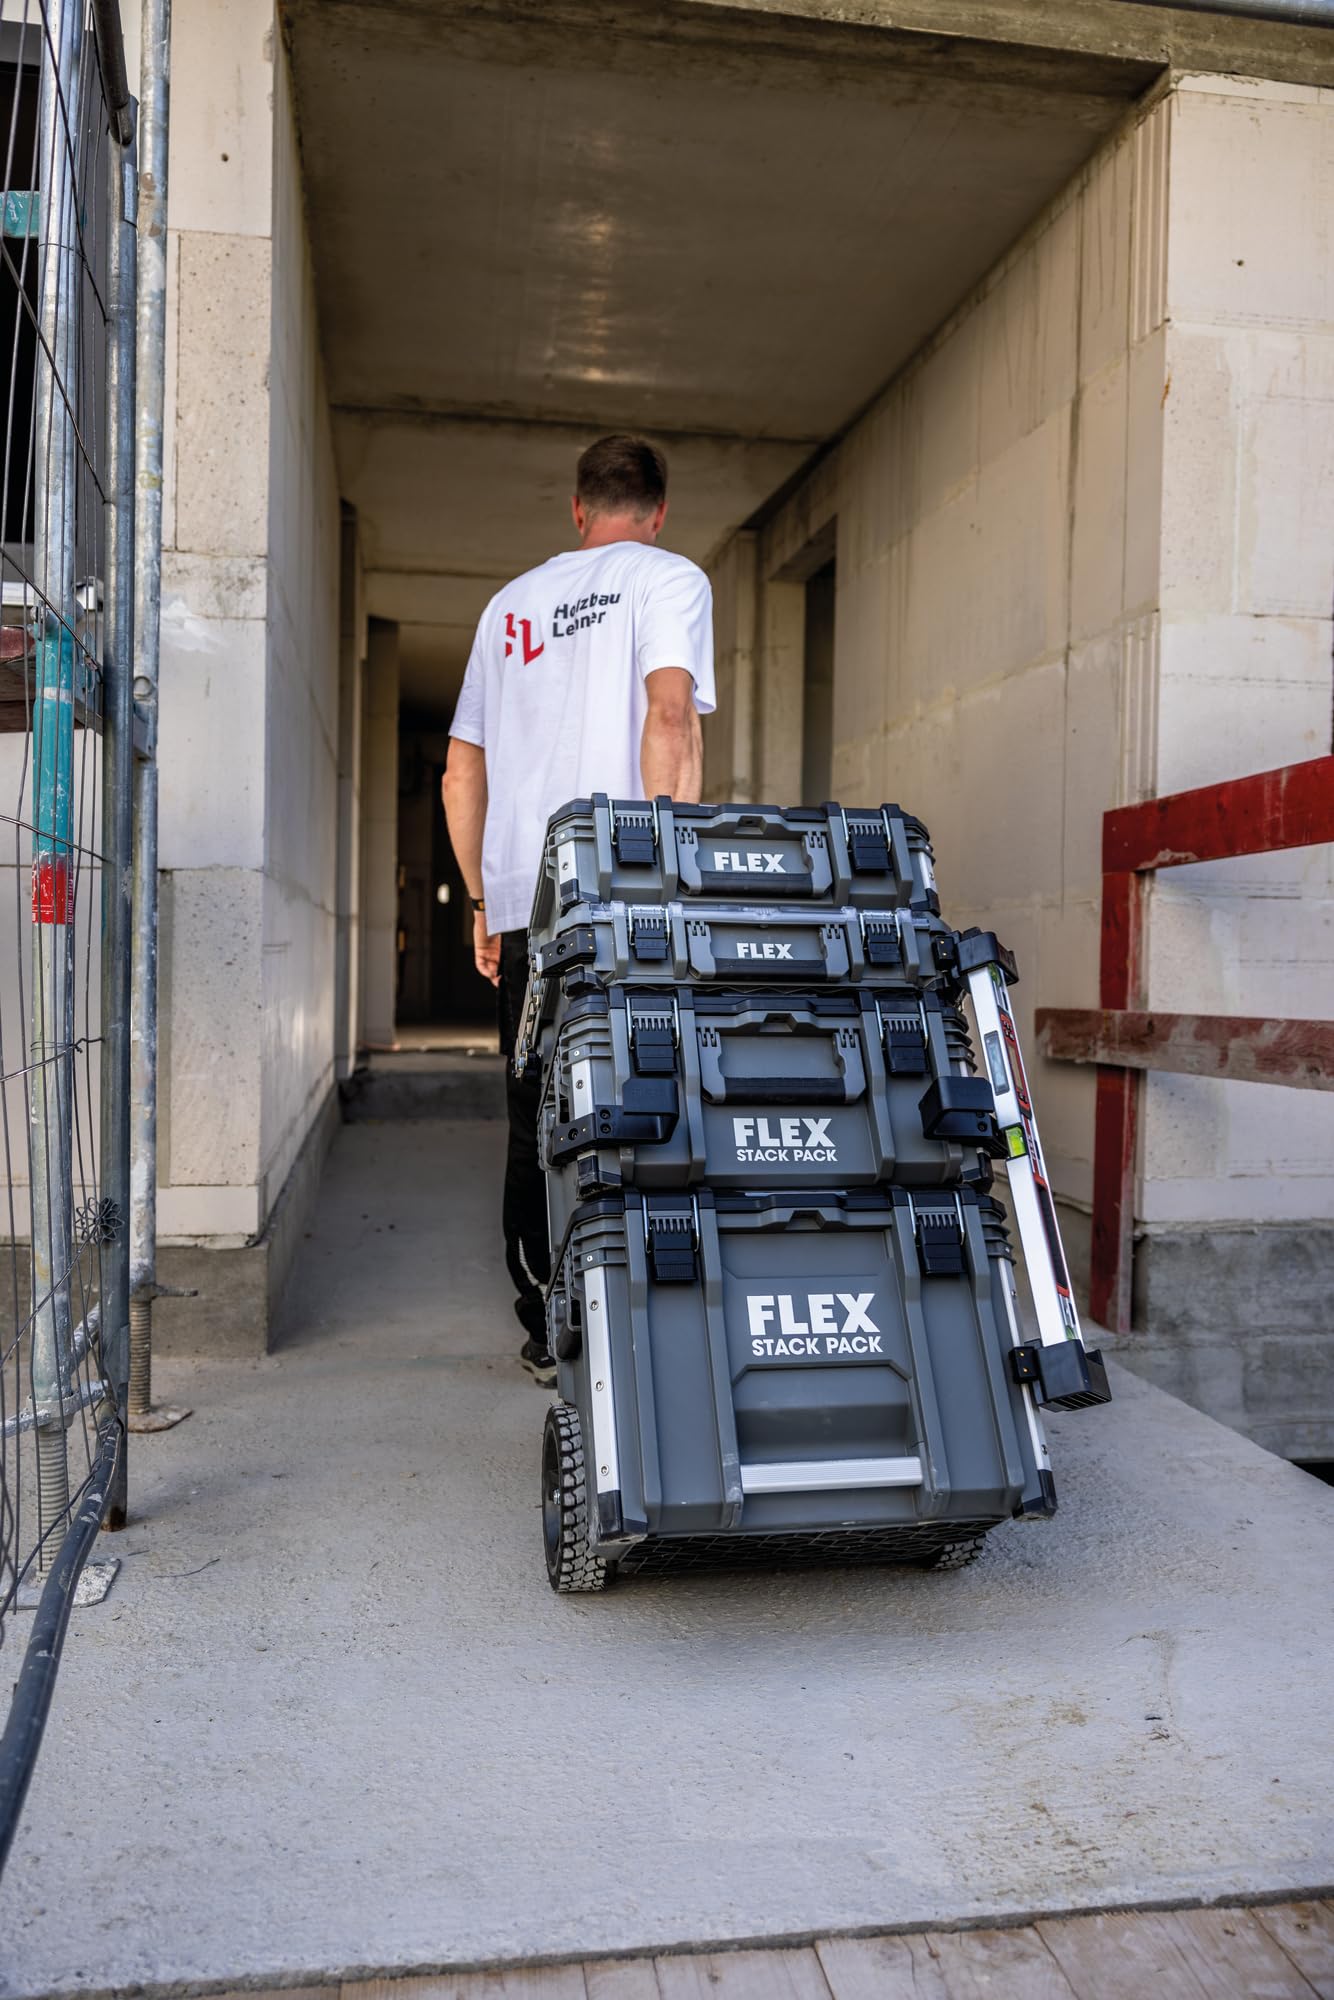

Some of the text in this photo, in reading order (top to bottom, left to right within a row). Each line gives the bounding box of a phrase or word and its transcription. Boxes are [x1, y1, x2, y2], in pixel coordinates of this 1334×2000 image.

[554, 592, 621, 620] Holzbau
[713, 851, 786, 873] FLEX
[736, 942, 794, 960] FLEX
[733, 1117, 836, 1147] FLEX
[736, 1149, 838, 1162] STACK PACK
[746, 1293, 881, 1336] FLEX
[752, 1335, 883, 1357] STACK PACK
